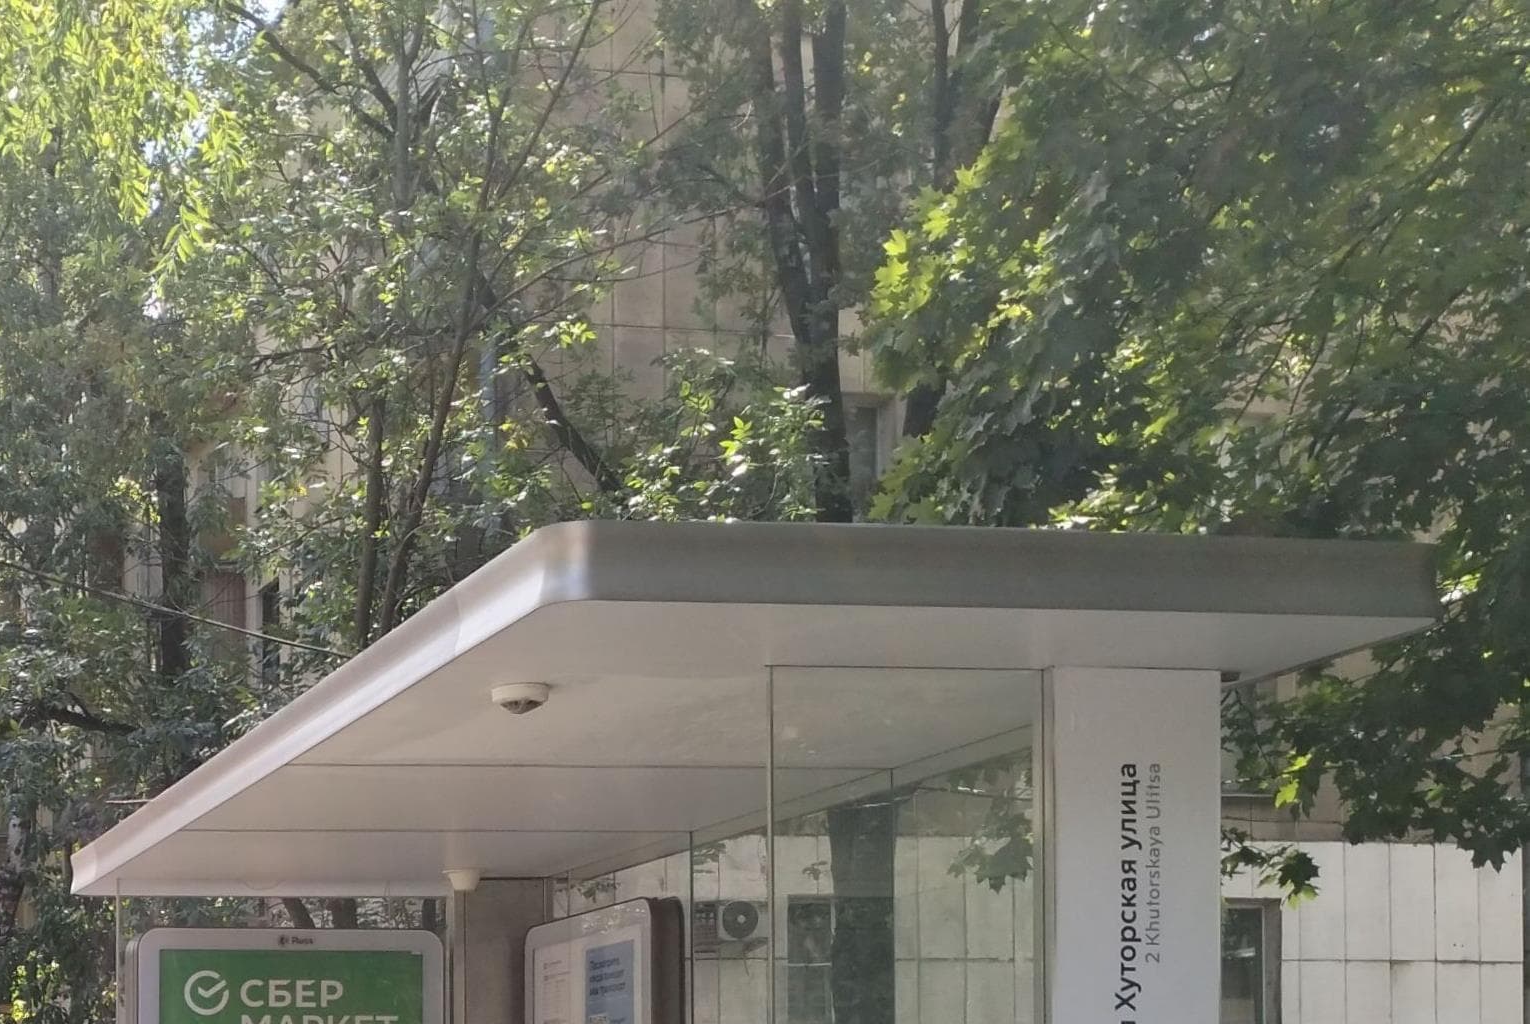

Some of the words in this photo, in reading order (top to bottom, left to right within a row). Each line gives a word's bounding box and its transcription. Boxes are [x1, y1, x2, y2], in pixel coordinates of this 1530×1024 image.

[1119, 763, 1142, 851] улица
[1145, 763, 1161, 820] Ulitsa
[1145, 826, 1165, 947] Khutorskaya
[1114, 859, 1142, 1012] Хуторская
[1145, 952, 1161, 964] 2
[239, 979, 344, 1008] СБЕР
